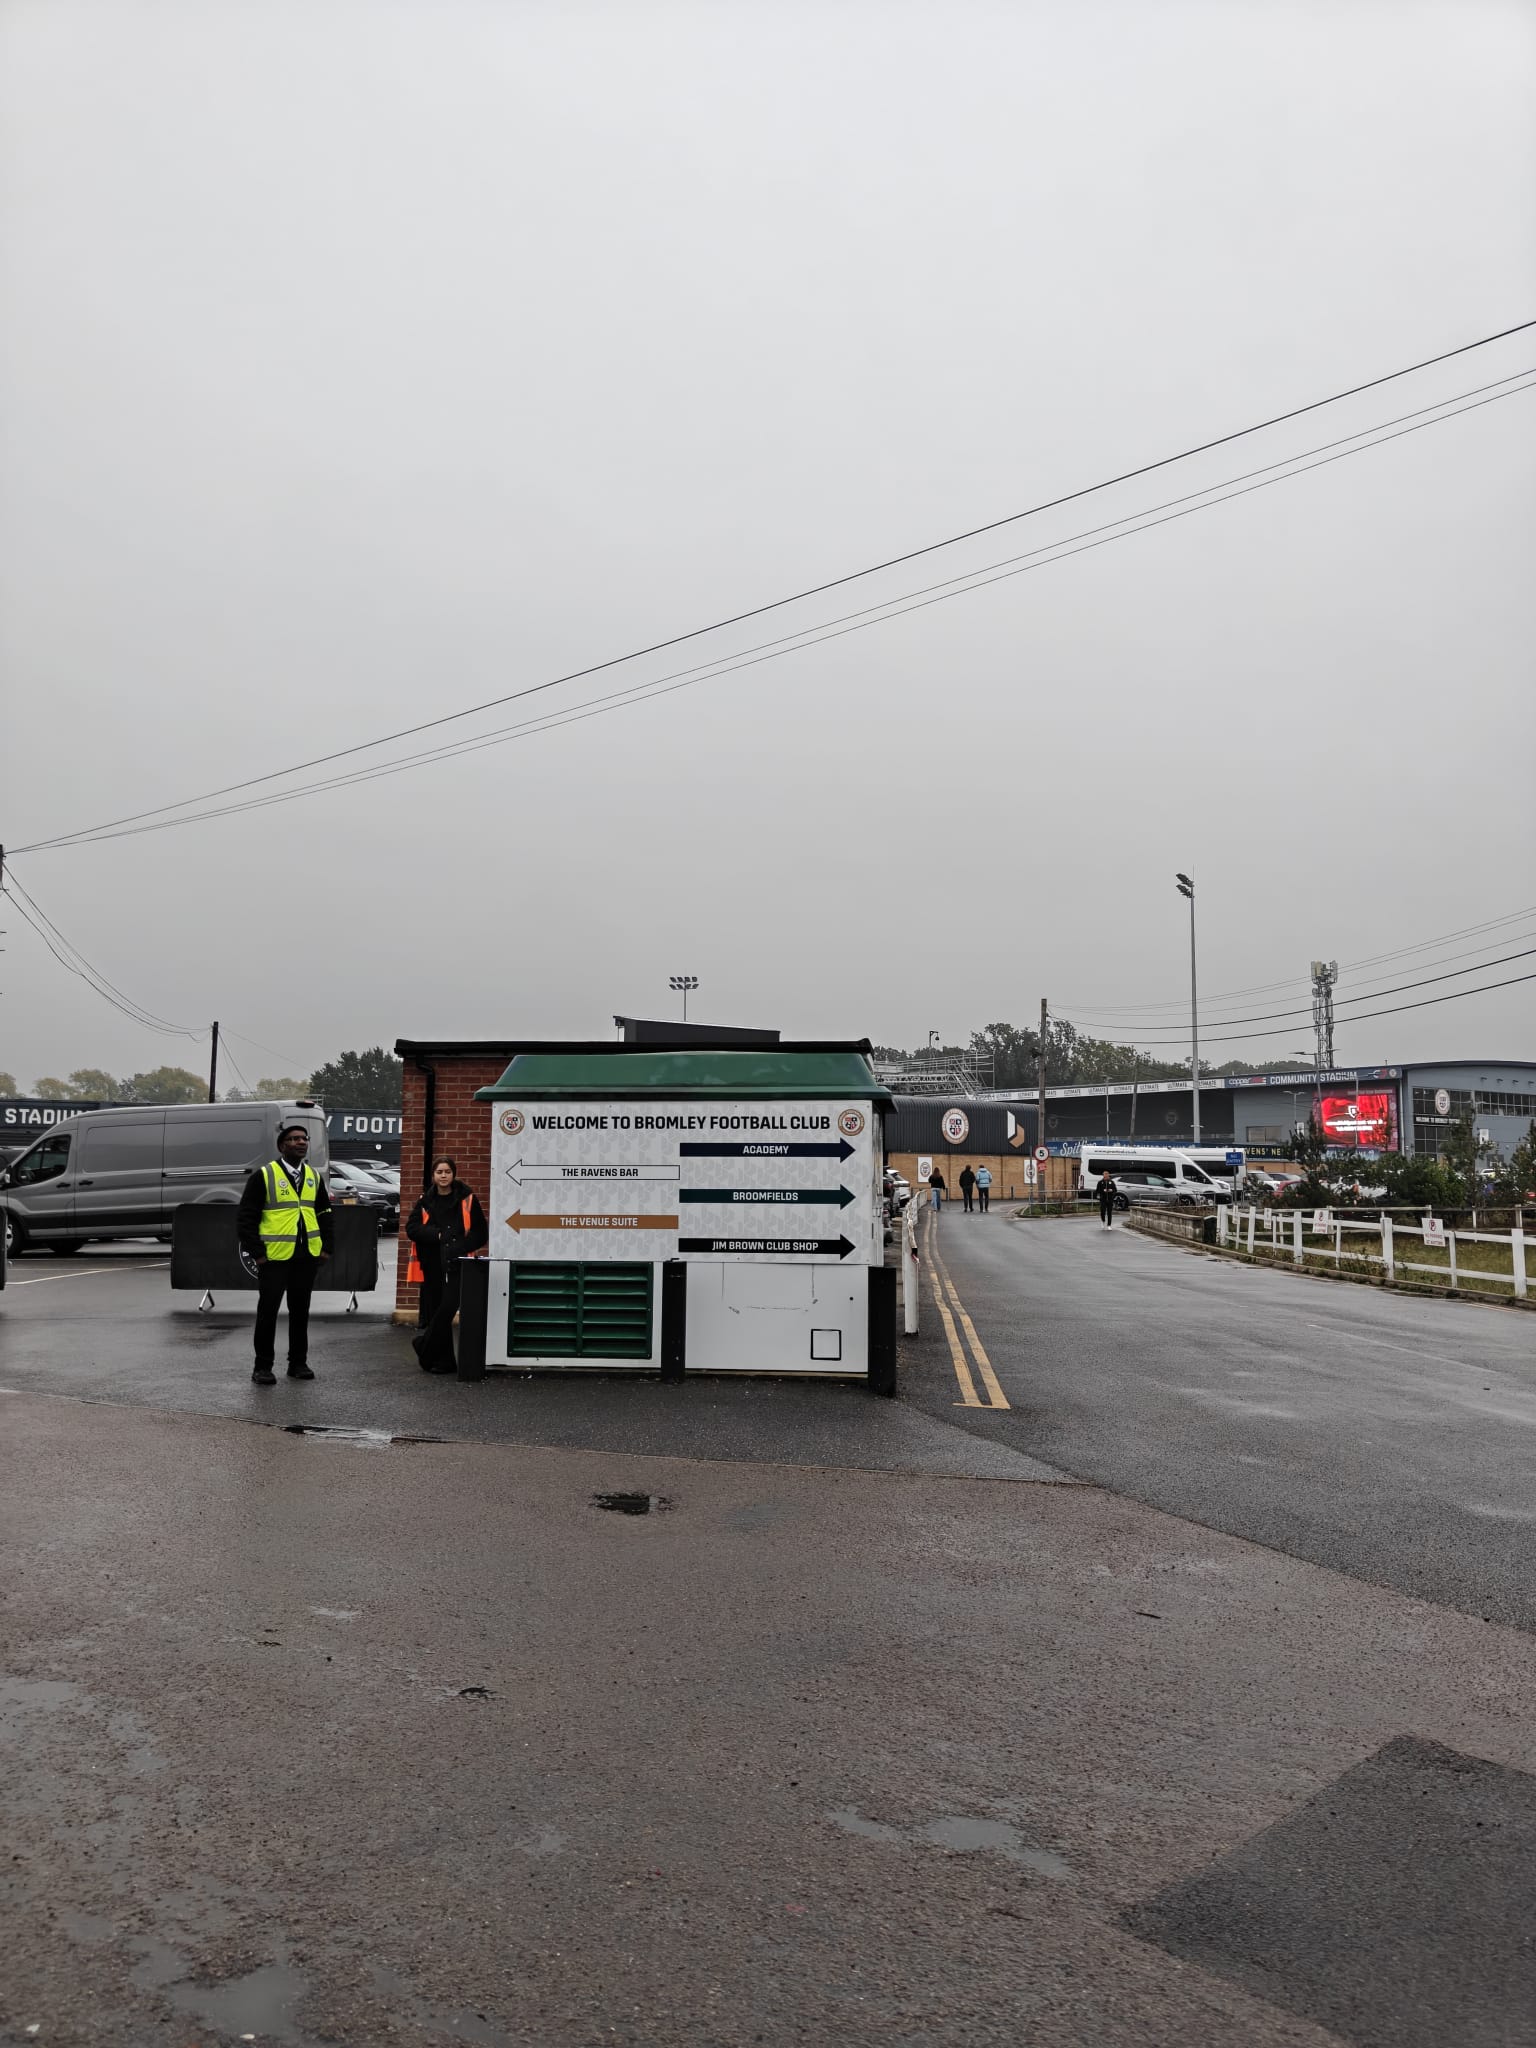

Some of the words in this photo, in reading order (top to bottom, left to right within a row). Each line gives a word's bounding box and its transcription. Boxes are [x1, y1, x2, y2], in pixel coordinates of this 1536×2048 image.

[1270, 1073, 1317, 1085] COMMUNITY
[1320, 1071, 1357, 1081] STADIUM
[5, 1108, 82, 1124] STADIU
[532, 1116, 608, 1129] WELCOME
[611, 1116, 631, 1129] TO
[634, 1116, 706, 1129] BROMLEY
[710, 1116, 787, 1129] FOOTBALL
[790, 1116, 830, 1129] CLUB
[743, 1145, 789, 1154] ACADEMY
[1039, 1149, 1045, 1157] 5
[561, 1168, 578, 1177] THE
[581, 1168, 618, 1177] RAVENS
[619, 1168, 639, 1177] BAR
[733, 1191, 799, 1201] BROOMFIELDS
[560, 1217, 577, 1226] THE
[579, 1217, 610, 1226] VENUE
[612, 1217, 638, 1226] SUITE
[712, 1241, 727, 1251] JIM
[729, 1241, 764, 1250] BROWN
[766, 1241, 791, 1251] CLUB
[793, 1241, 819, 1251] SHOP
